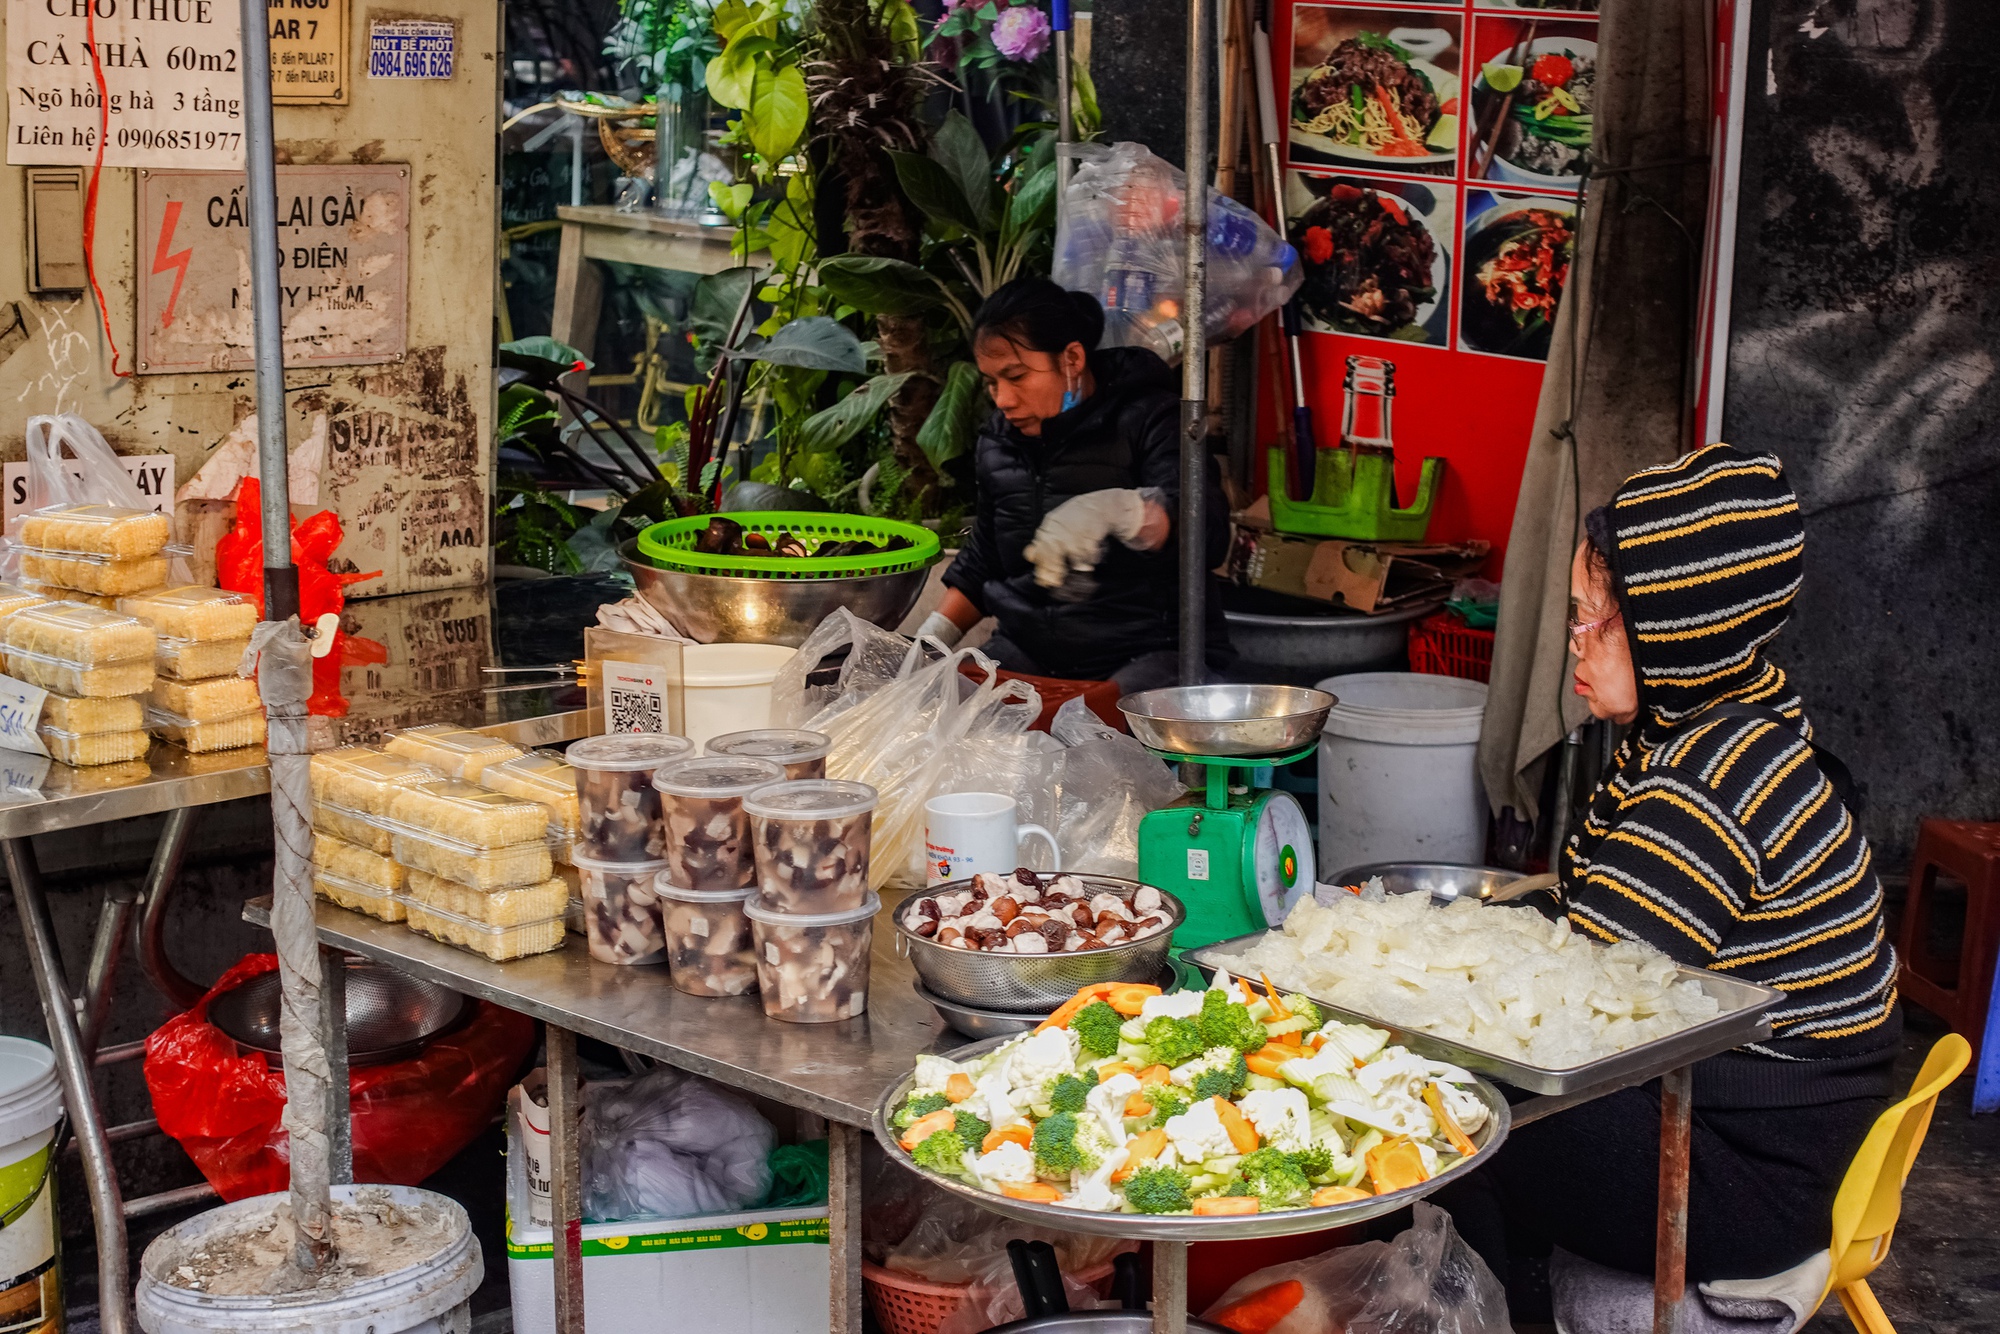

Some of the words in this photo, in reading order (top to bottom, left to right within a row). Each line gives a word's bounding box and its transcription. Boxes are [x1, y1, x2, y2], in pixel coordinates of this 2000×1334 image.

[307, 20, 318, 40] 7
[27, 34, 71, 66] CẢ
[81, 37, 149, 68] NHÀ
[167, 46, 237, 72] 60m2
[372, 37, 398, 50] HÚT
[420, 37, 452, 51] PHỐT
[298, 52, 327, 65] PILLAR
[372, 51, 452, 77] 0984.696.626
[301, 70, 328, 83] PILLAR
[18, 87, 63, 112] Ngõ
[130, 91, 154, 111] hà
[173, 92, 185, 111] 3
[194, 88, 240, 118] tầng
[16, 125, 63, 146] Liên
[118, 128, 241, 151] 0906851977
[207, 186, 250, 228] CẤ
[321, 186, 365, 226] GẦ
[128, 462, 166, 496] ÁY
